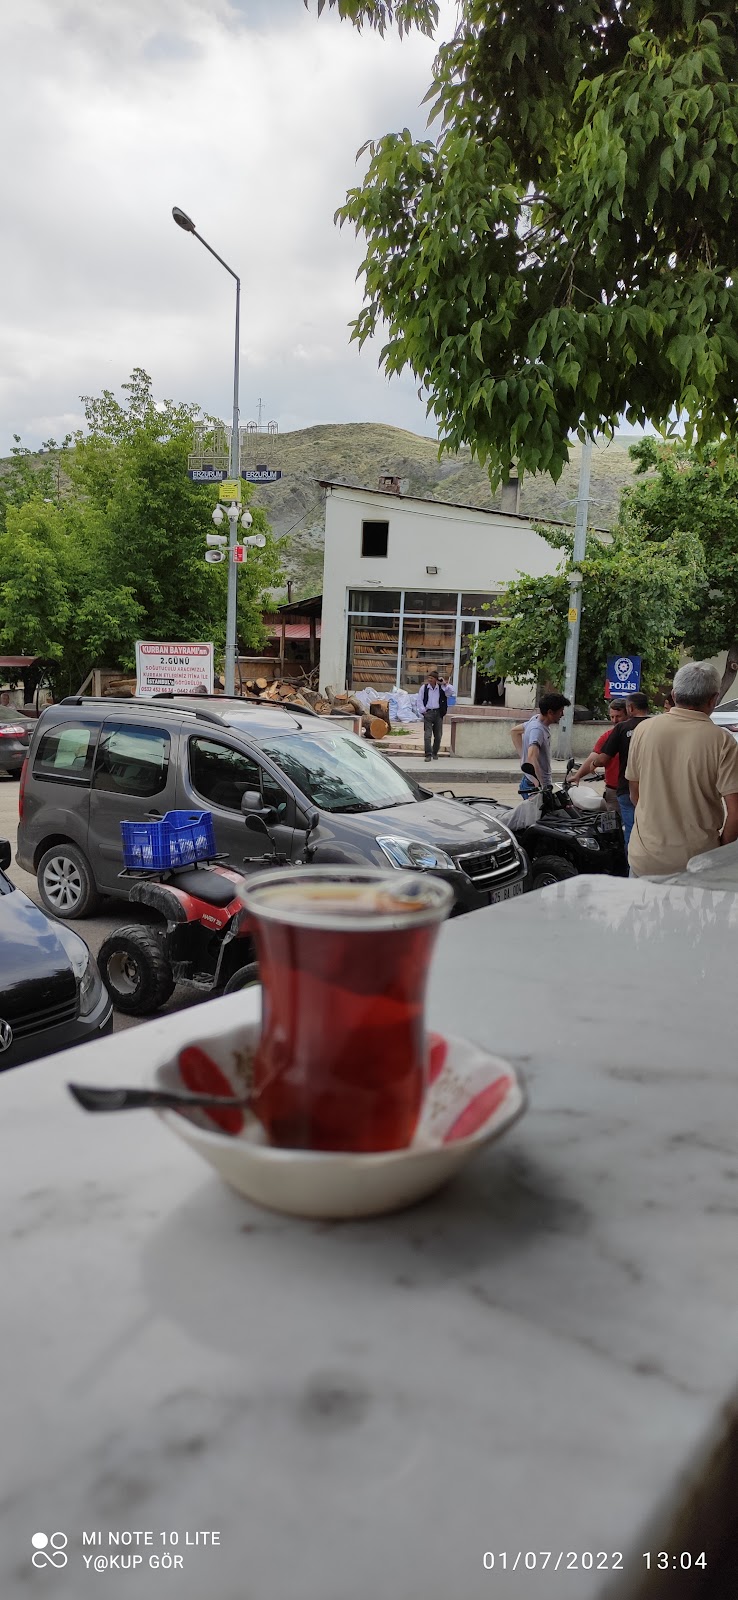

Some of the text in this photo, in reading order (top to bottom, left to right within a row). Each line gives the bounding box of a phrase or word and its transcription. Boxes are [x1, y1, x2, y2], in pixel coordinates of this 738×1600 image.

[142, 645, 168, 653] KURBAN
[160, 657, 190, 665] 2.GÜNÜ
[608, 681, 637, 690] POLİS
